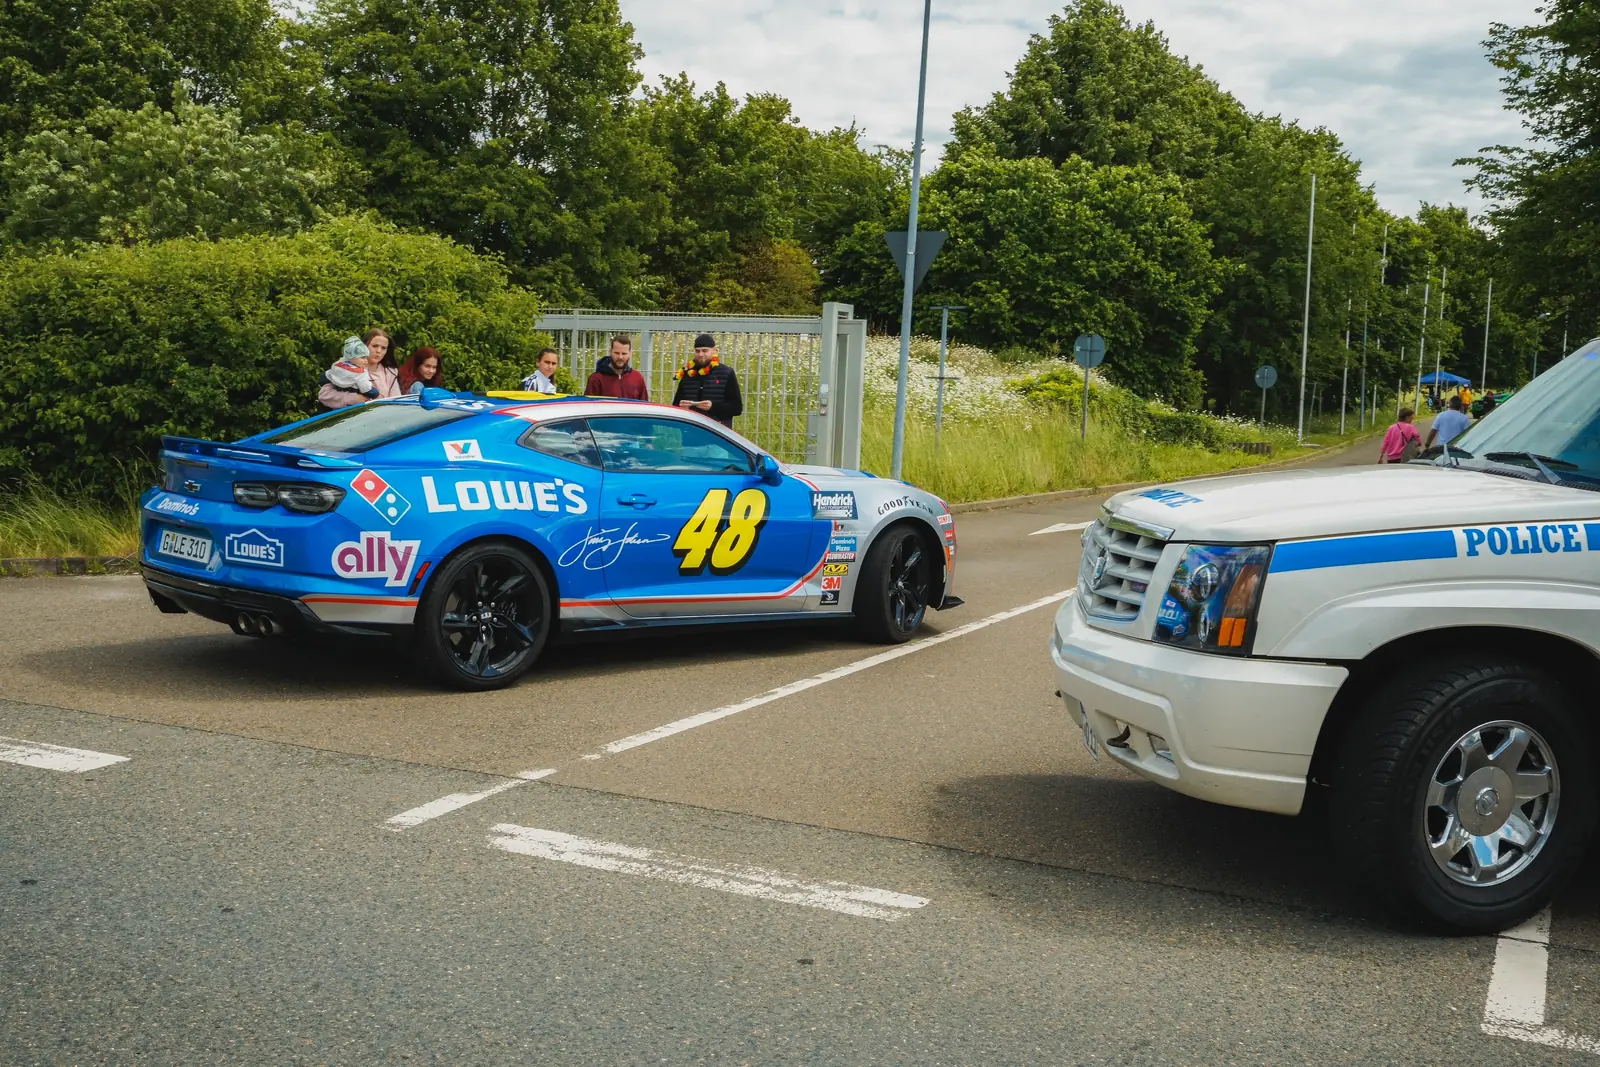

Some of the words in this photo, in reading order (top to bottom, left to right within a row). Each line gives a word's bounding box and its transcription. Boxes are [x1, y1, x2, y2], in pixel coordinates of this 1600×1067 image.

[421, 475, 588, 515] LOWE'S
[813, 493, 853, 510] Hendrick
[877, 495, 934, 516] GOODYEAR
[157, 497, 200, 516] Domino's
[674, 487, 769, 575] 48
[831, 537, 856, 545] Domino's
[1463, 523, 1582, 557] POLICE
[162, 533, 170, 550] G
[174, 537, 185, 555] LE
[187, 538, 207, 560] 310
[233, 539, 276, 561] LOWE'S
[336, 536, 416, 582] ally
[822, 576, 841, 590] 3M
